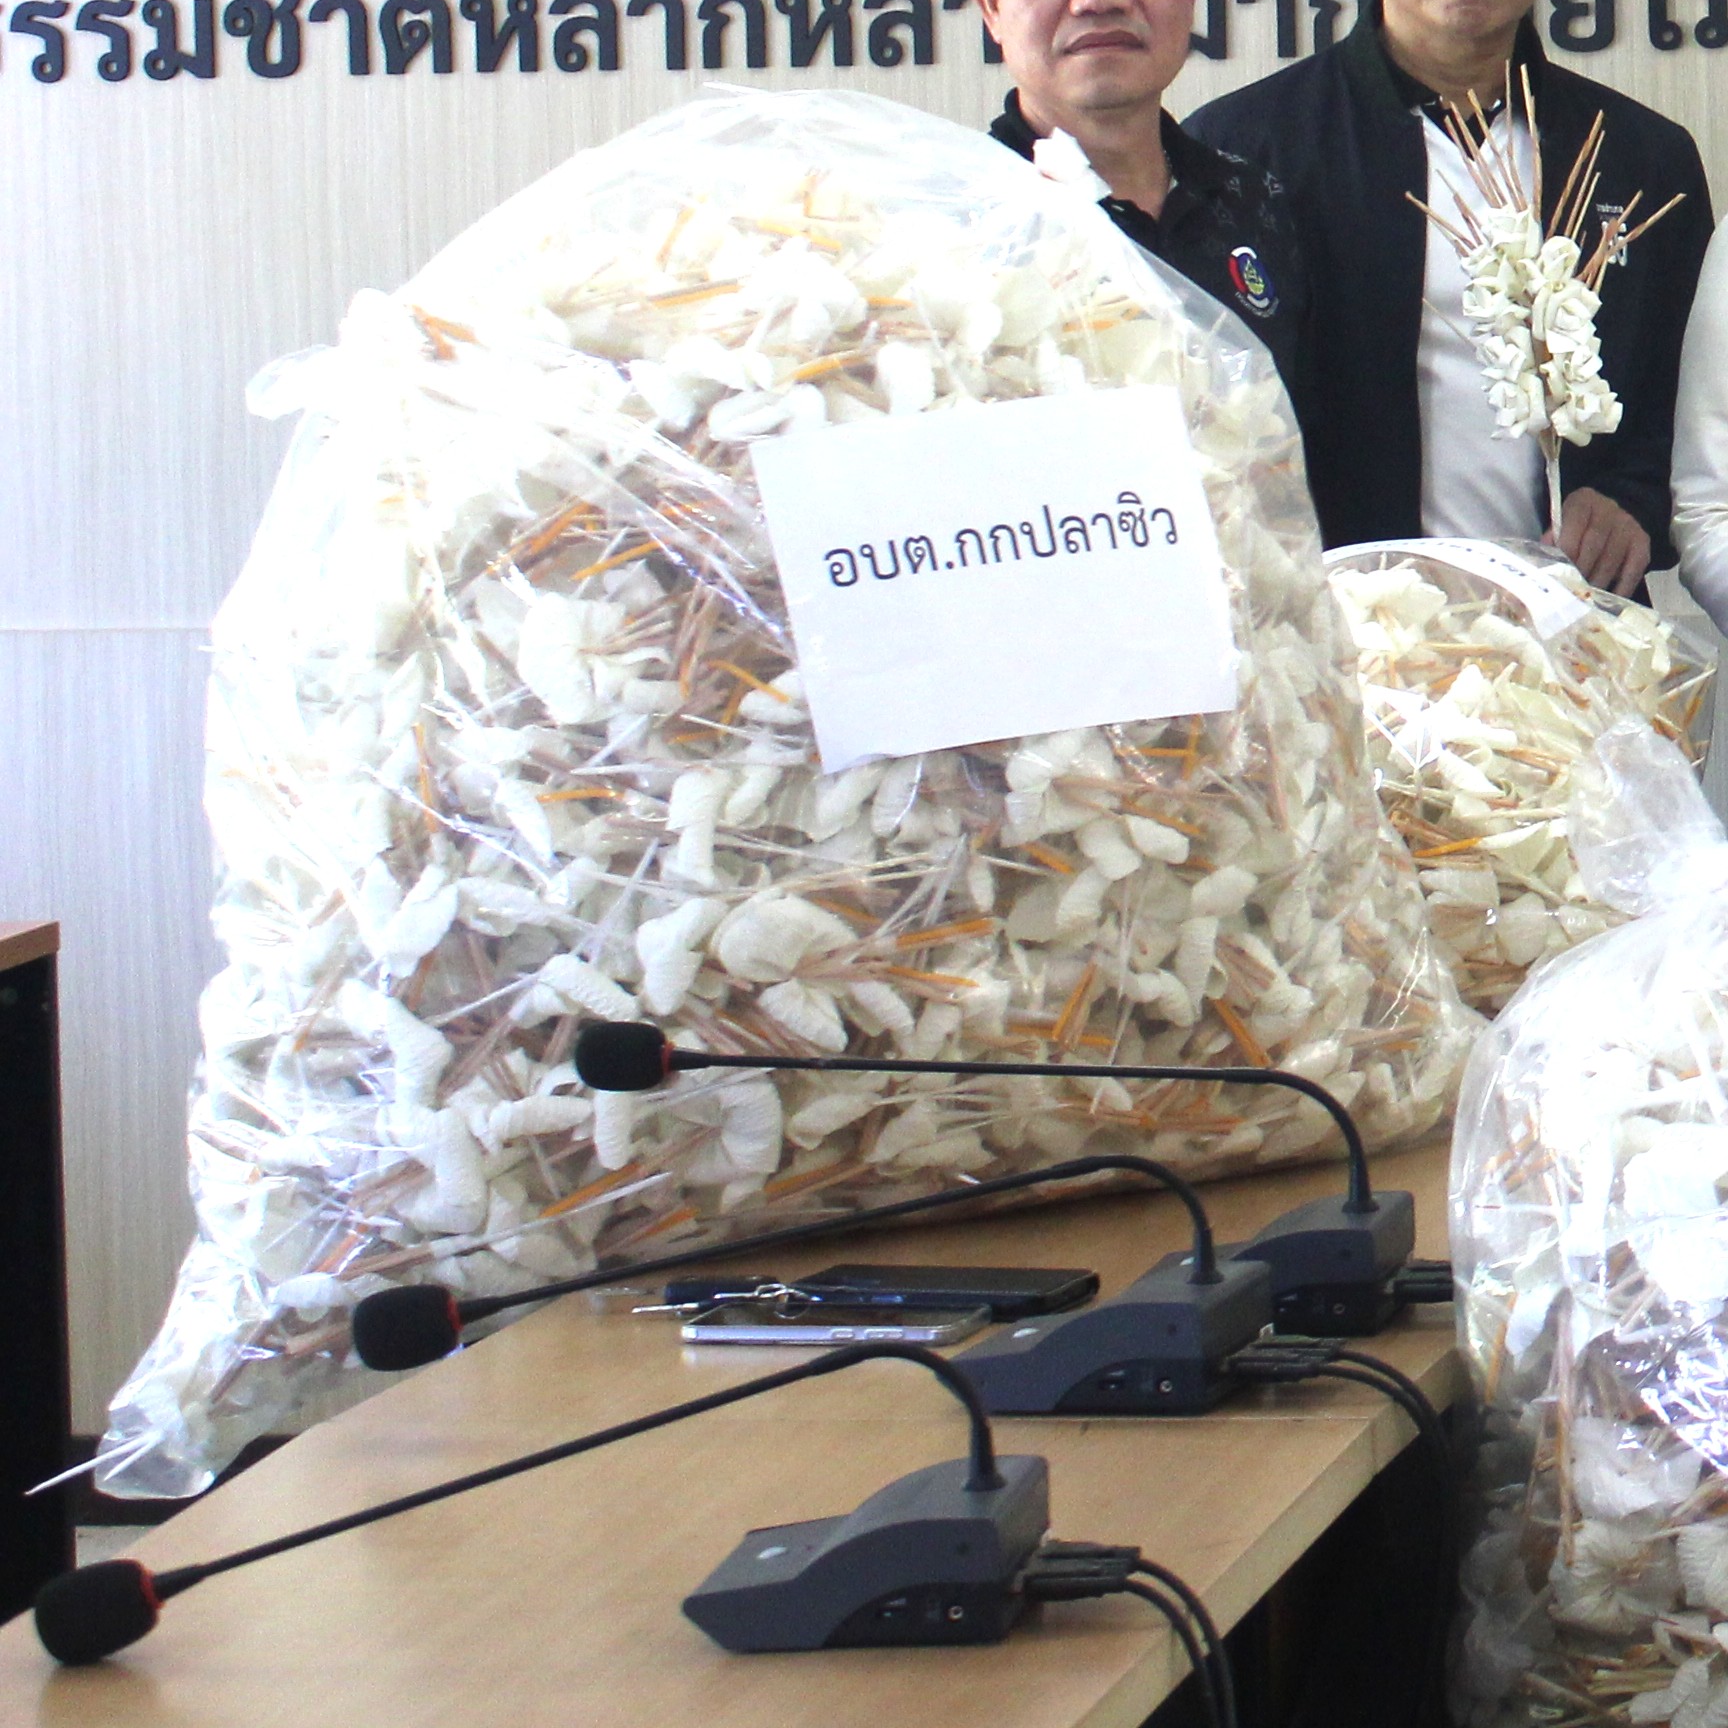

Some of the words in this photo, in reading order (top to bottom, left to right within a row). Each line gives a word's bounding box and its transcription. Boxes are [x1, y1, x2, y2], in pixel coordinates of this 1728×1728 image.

[824, 491, 1179, 588] อบต.กกปลาซิว
